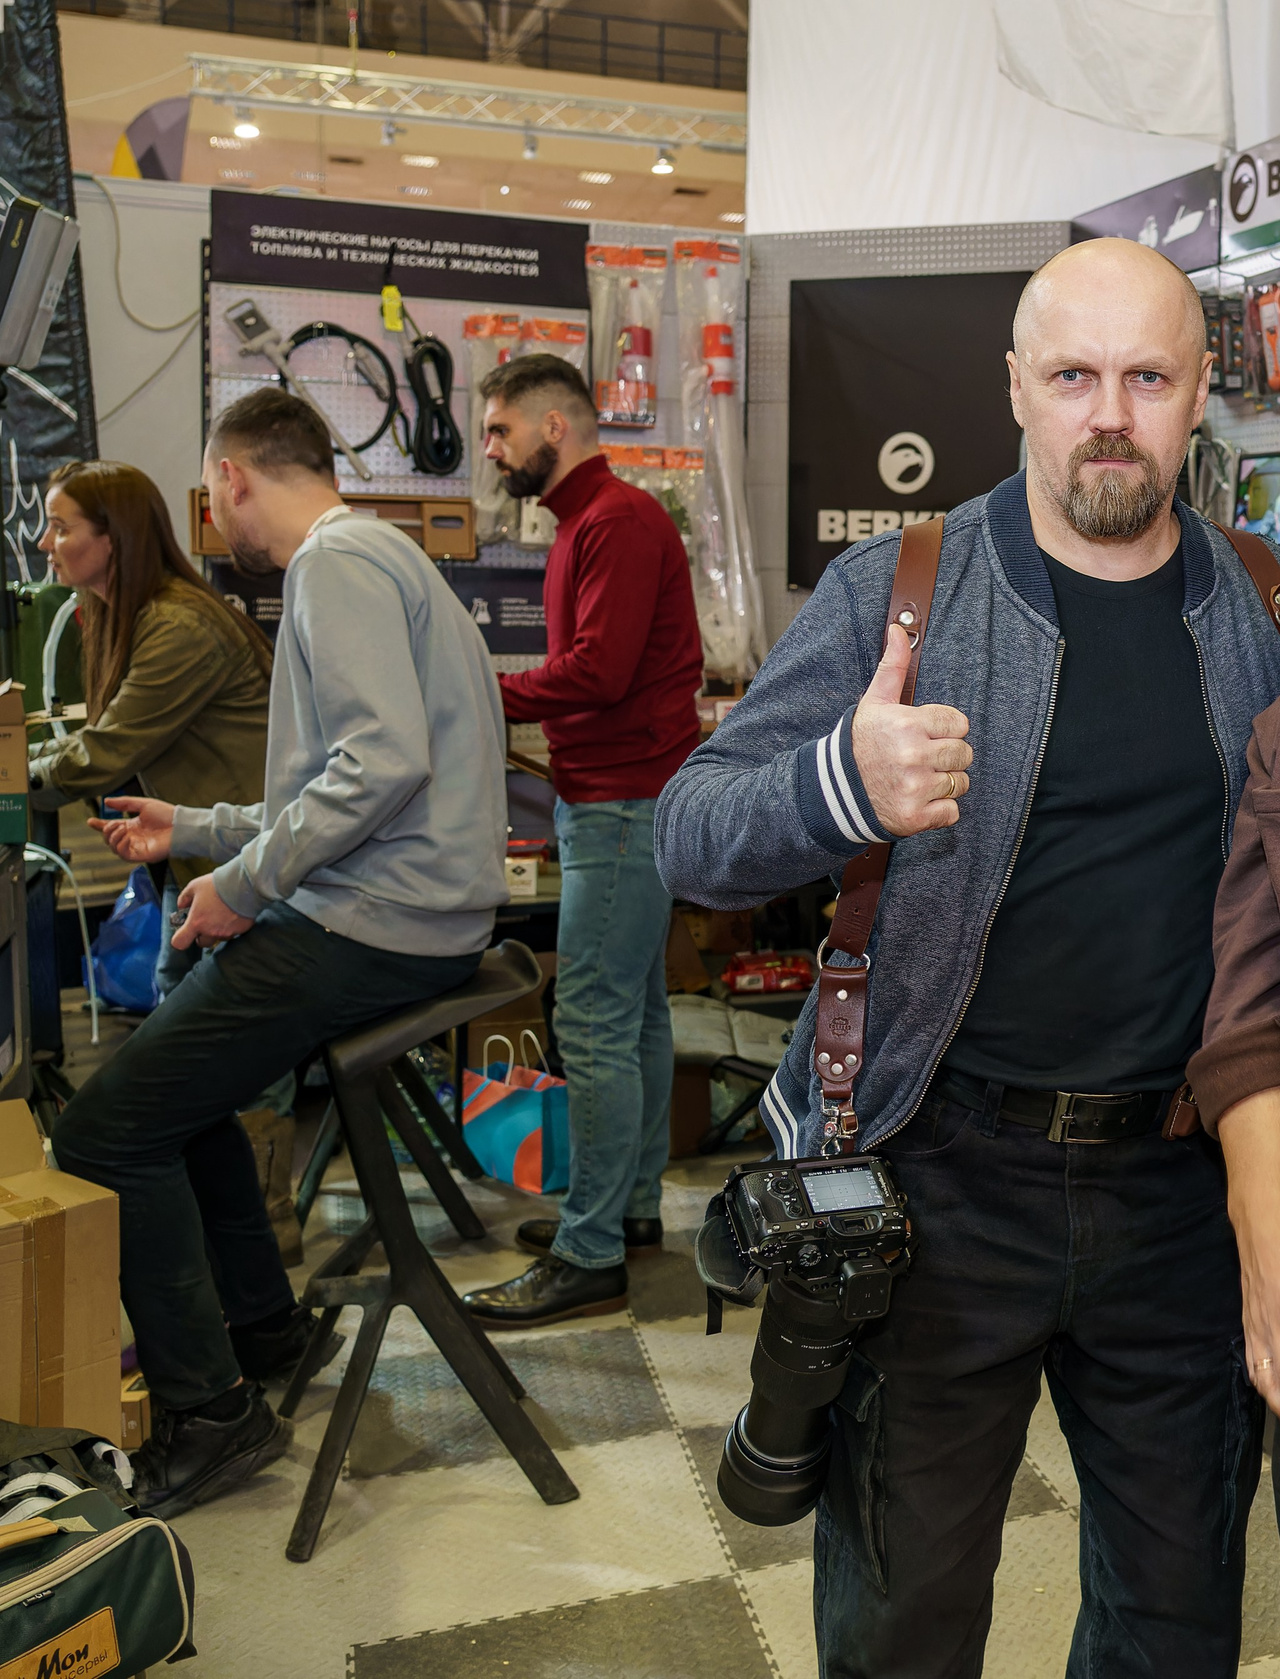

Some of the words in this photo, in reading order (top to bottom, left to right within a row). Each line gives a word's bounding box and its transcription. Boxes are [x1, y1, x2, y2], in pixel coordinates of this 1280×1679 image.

[250, 224, 369, 246] ЭЛЕКТРИЧЕСКИЕ
[461, 243, 540, 261] ПЕРЕКАЧКИ
[251, 241, 323, 260] ТОПЛИВА
[326, 247, 338, 260] И
[448, 256, 540, 278] ЖИДКОСТЕЙ
